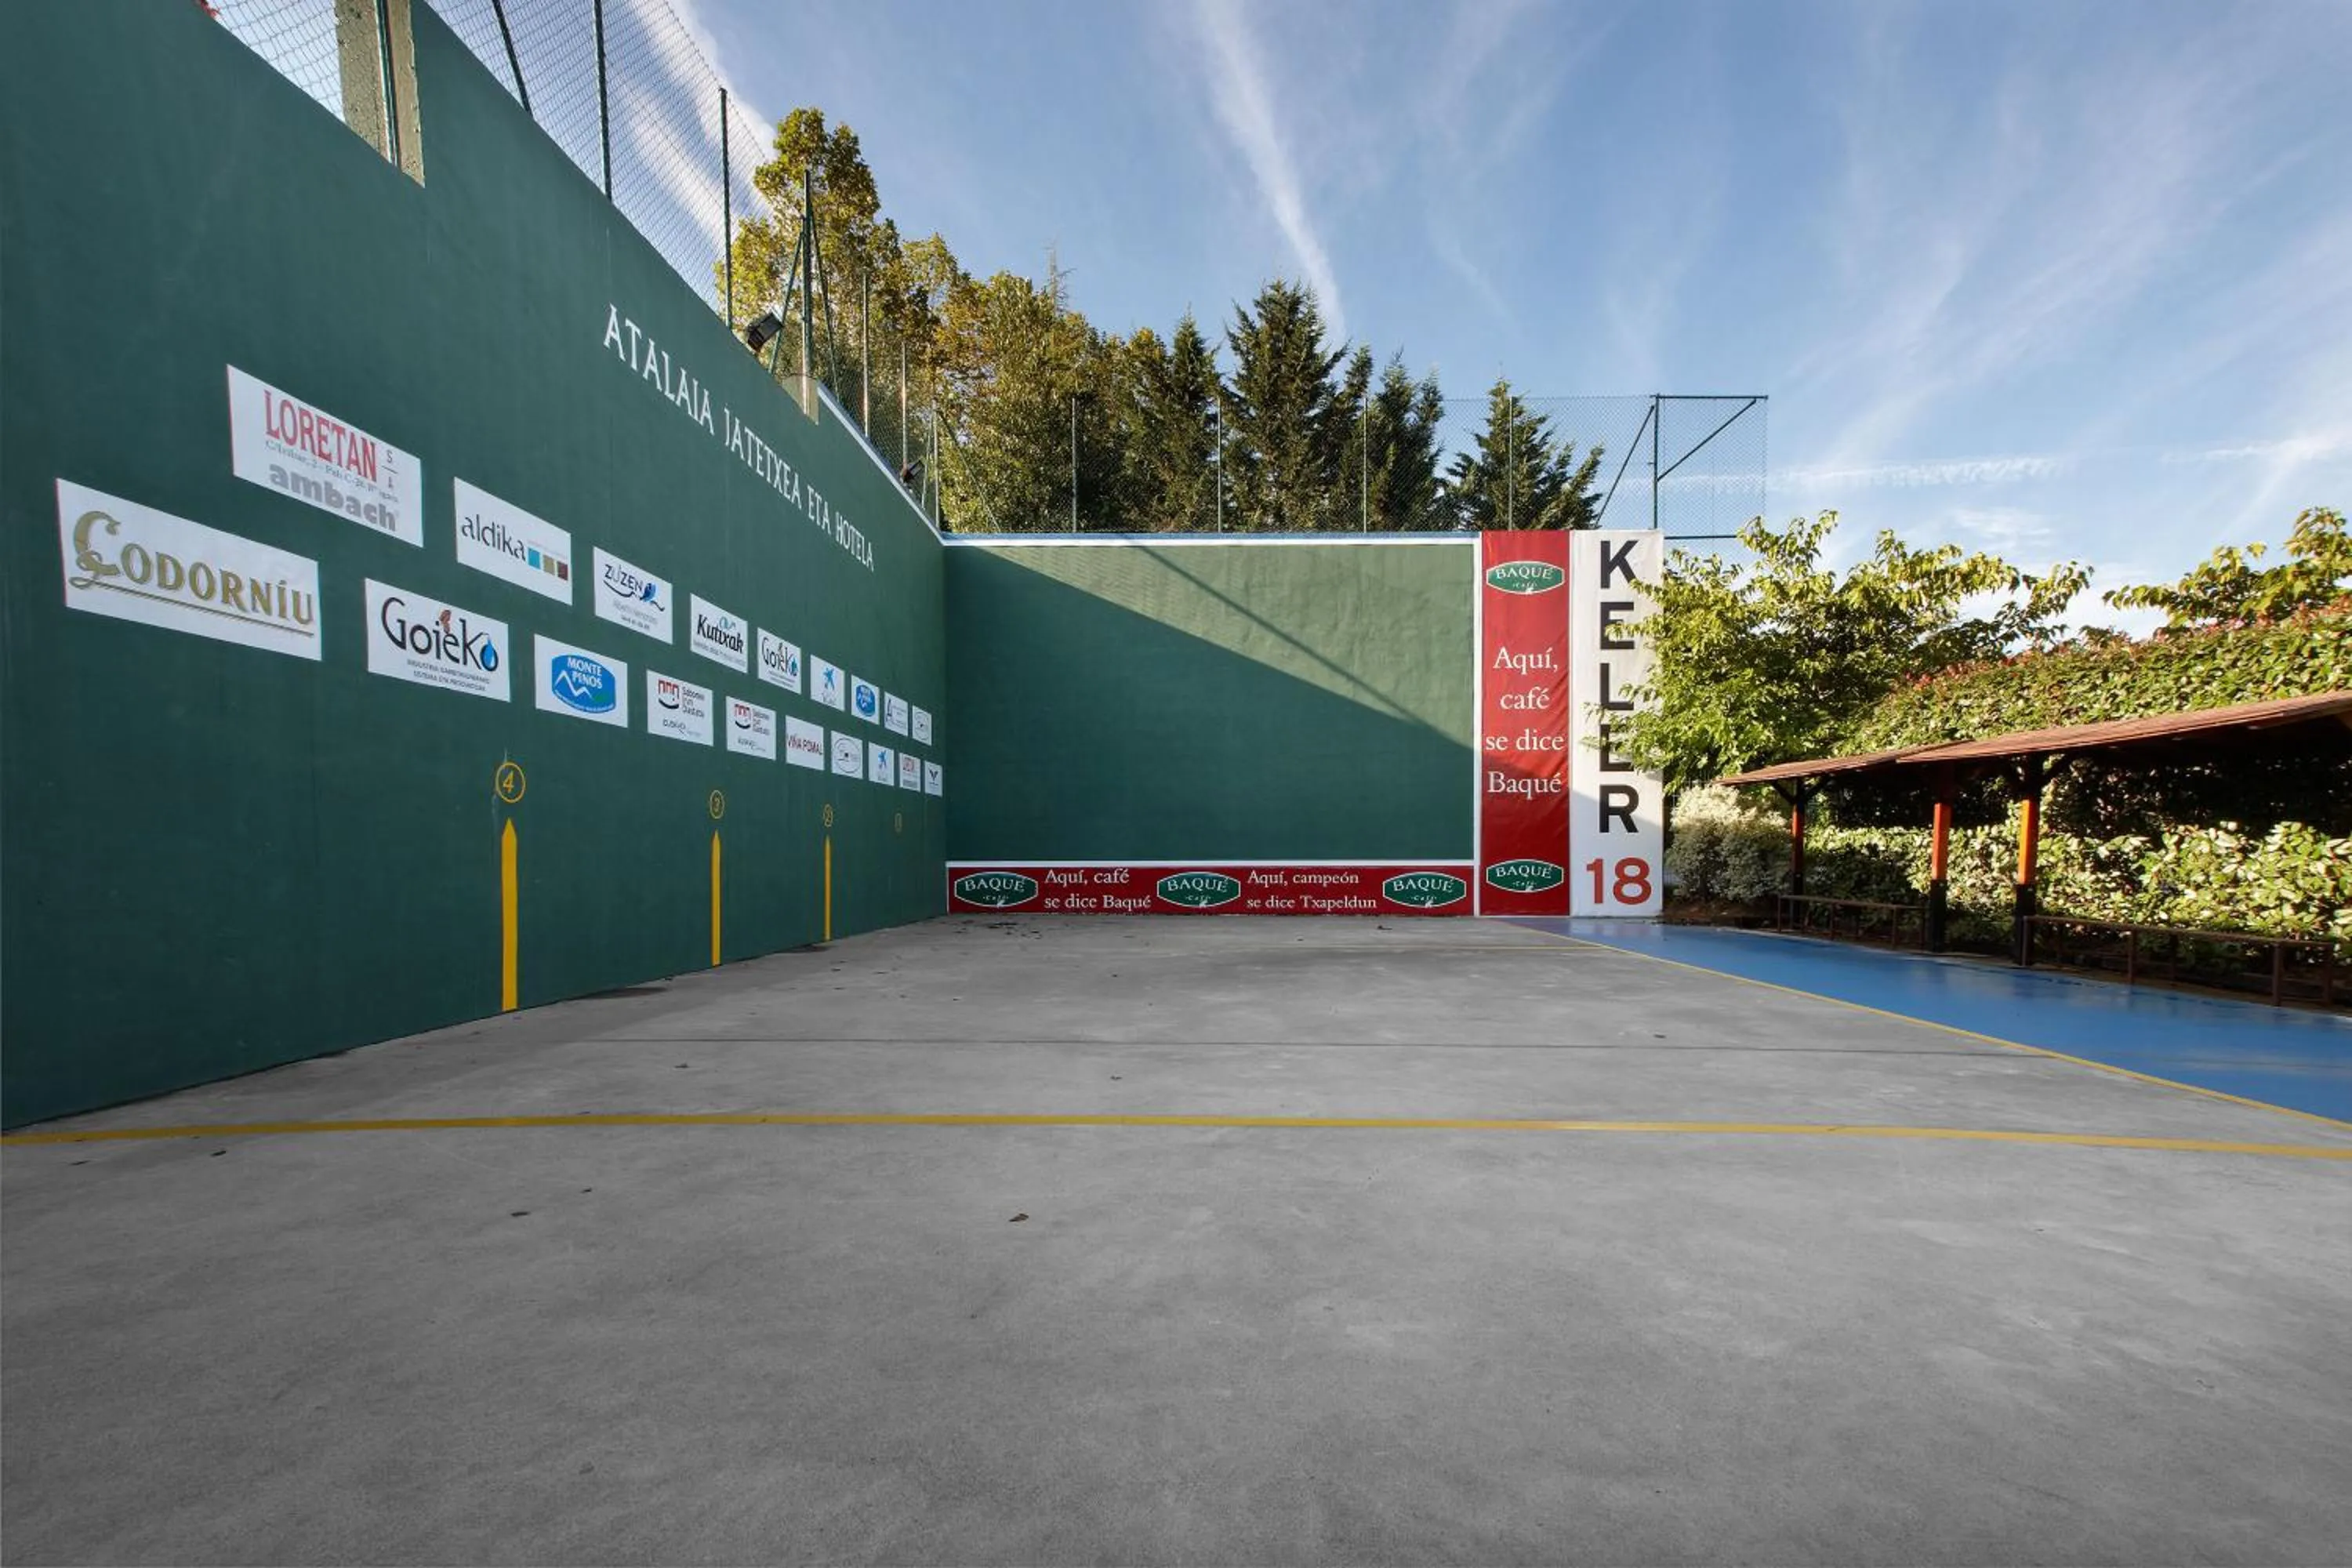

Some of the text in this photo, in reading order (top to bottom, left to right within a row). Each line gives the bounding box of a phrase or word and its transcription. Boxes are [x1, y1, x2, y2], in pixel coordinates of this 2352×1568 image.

[263, 389, 377, 483] LORETAN
[604, 303, 715, 436] ATALAIA
[807, 485, 832, 535] ETA
[835, 511, 874, 572] HOTELA
[270, 463, 396, 532] ambach
[461, 514, 526, 561] aldika
[69, 510, 314, 626] CODORNÍU
[1495, 565, 1554, 579] BAQUÉ
[381, 597, 499, 672] Goieko
[568, 657, 602, 676] MONTE
[1493, 645, 1559, 675] Aquí,
[1501, 686, 1550, 710] café
[1486, 728, 1564, 751] se dice
[503, 770, 514, 793] 4
[1487, 771, 1562, 800] Baqué
[1044, 868, 1130, 887] Aquí, café
[1247, 869, 1359, 887] Aquí, campeón
[1496, 864, 1552, 879] BAQUÉ
[1586, 857, 1652, 906] 18
[964, 877, 1025, 892] BAQUÉ
[1167, 877, 1229, 892] BAQUÉ
[1393, 877, 1454, 892] BAQUÉ
[1044, 893, 1152, 911] se dice Baqué
[1247, 895, 1377, 911] se dice Txapeldun
